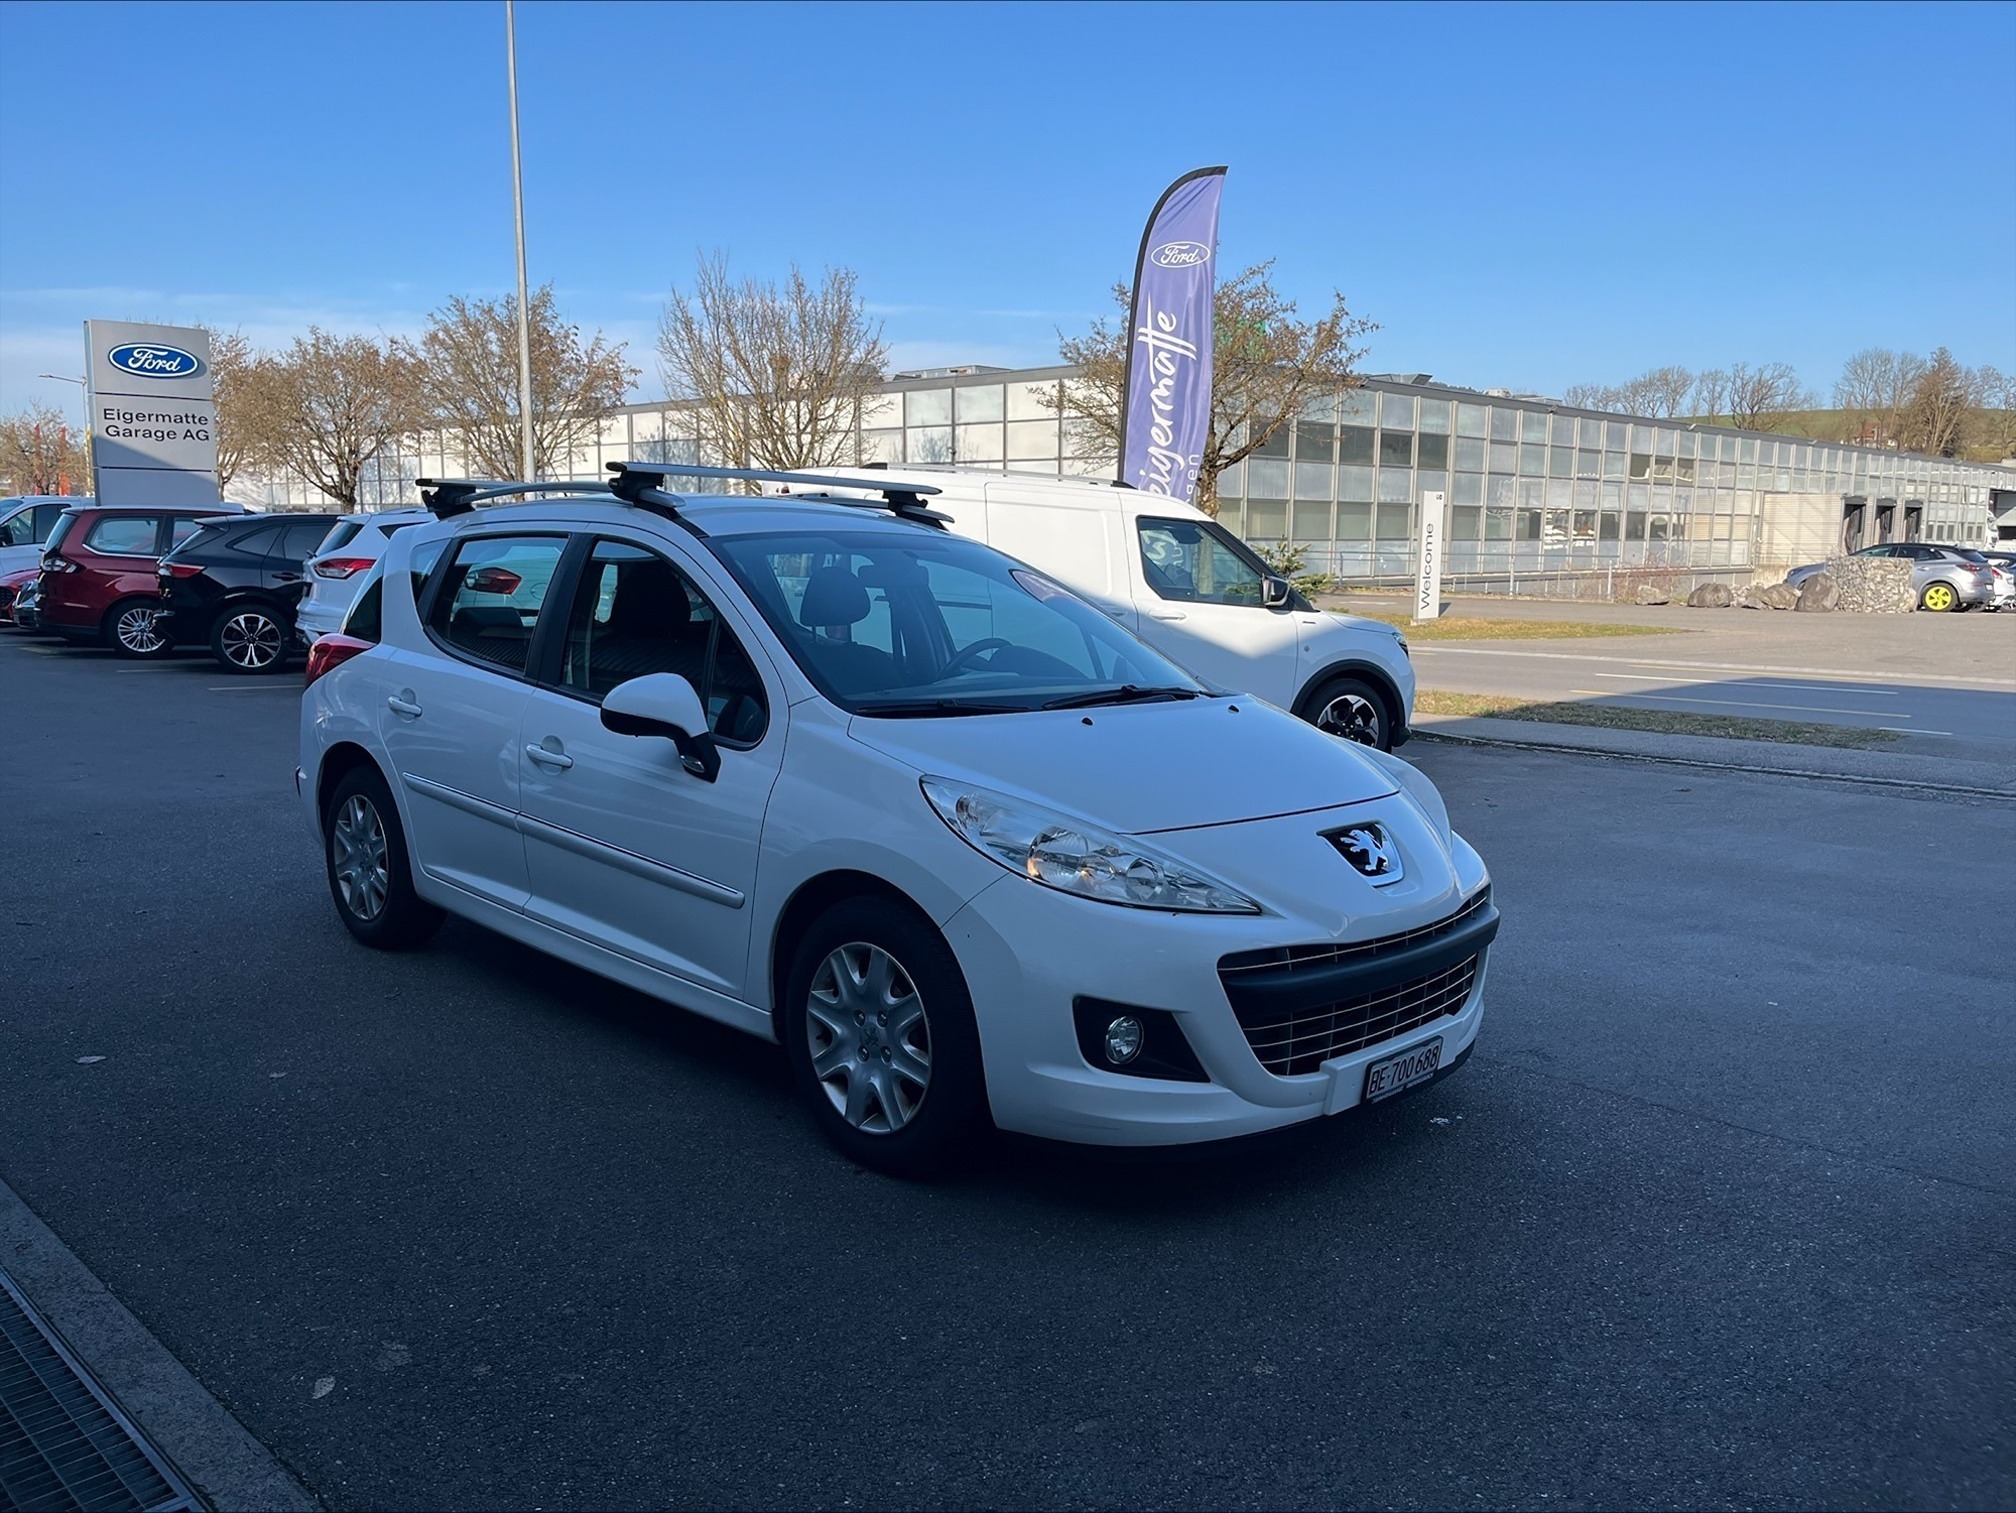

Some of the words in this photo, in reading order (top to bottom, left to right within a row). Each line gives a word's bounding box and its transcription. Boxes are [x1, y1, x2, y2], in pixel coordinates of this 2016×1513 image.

[1160, 243, 1199, 266] Ford
[127, 347, 182, 372] Ford
[103, 408, 209, 425] Eigermatte
[105, 424, 177, 442] Garage
[183, 428, 209, 441] AG
[1420, 523, 1434, 610] Welcome
